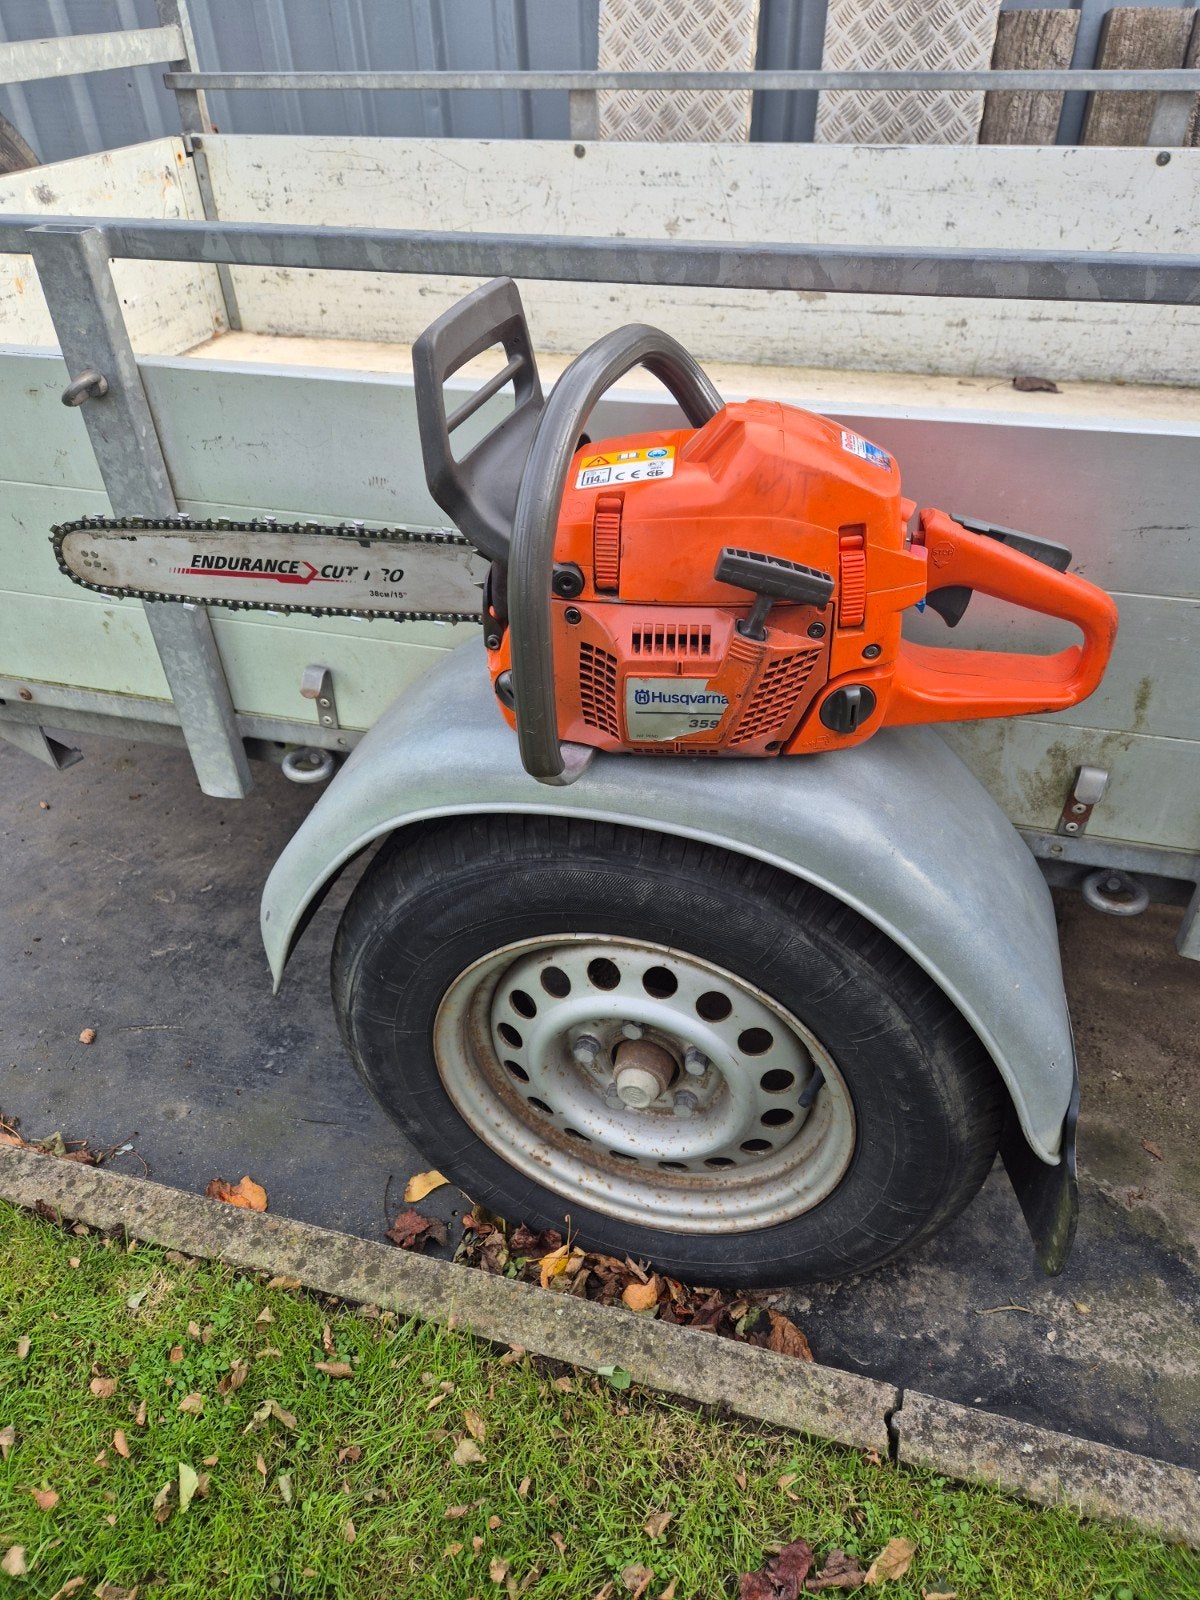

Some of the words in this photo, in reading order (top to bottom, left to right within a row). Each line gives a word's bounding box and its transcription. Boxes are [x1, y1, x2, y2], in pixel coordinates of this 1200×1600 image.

[191, 555, 300, 573] ENDURANCE
[320, 564, 358, 579] CUT
[651, 692, 729, 705] Husqvarna
